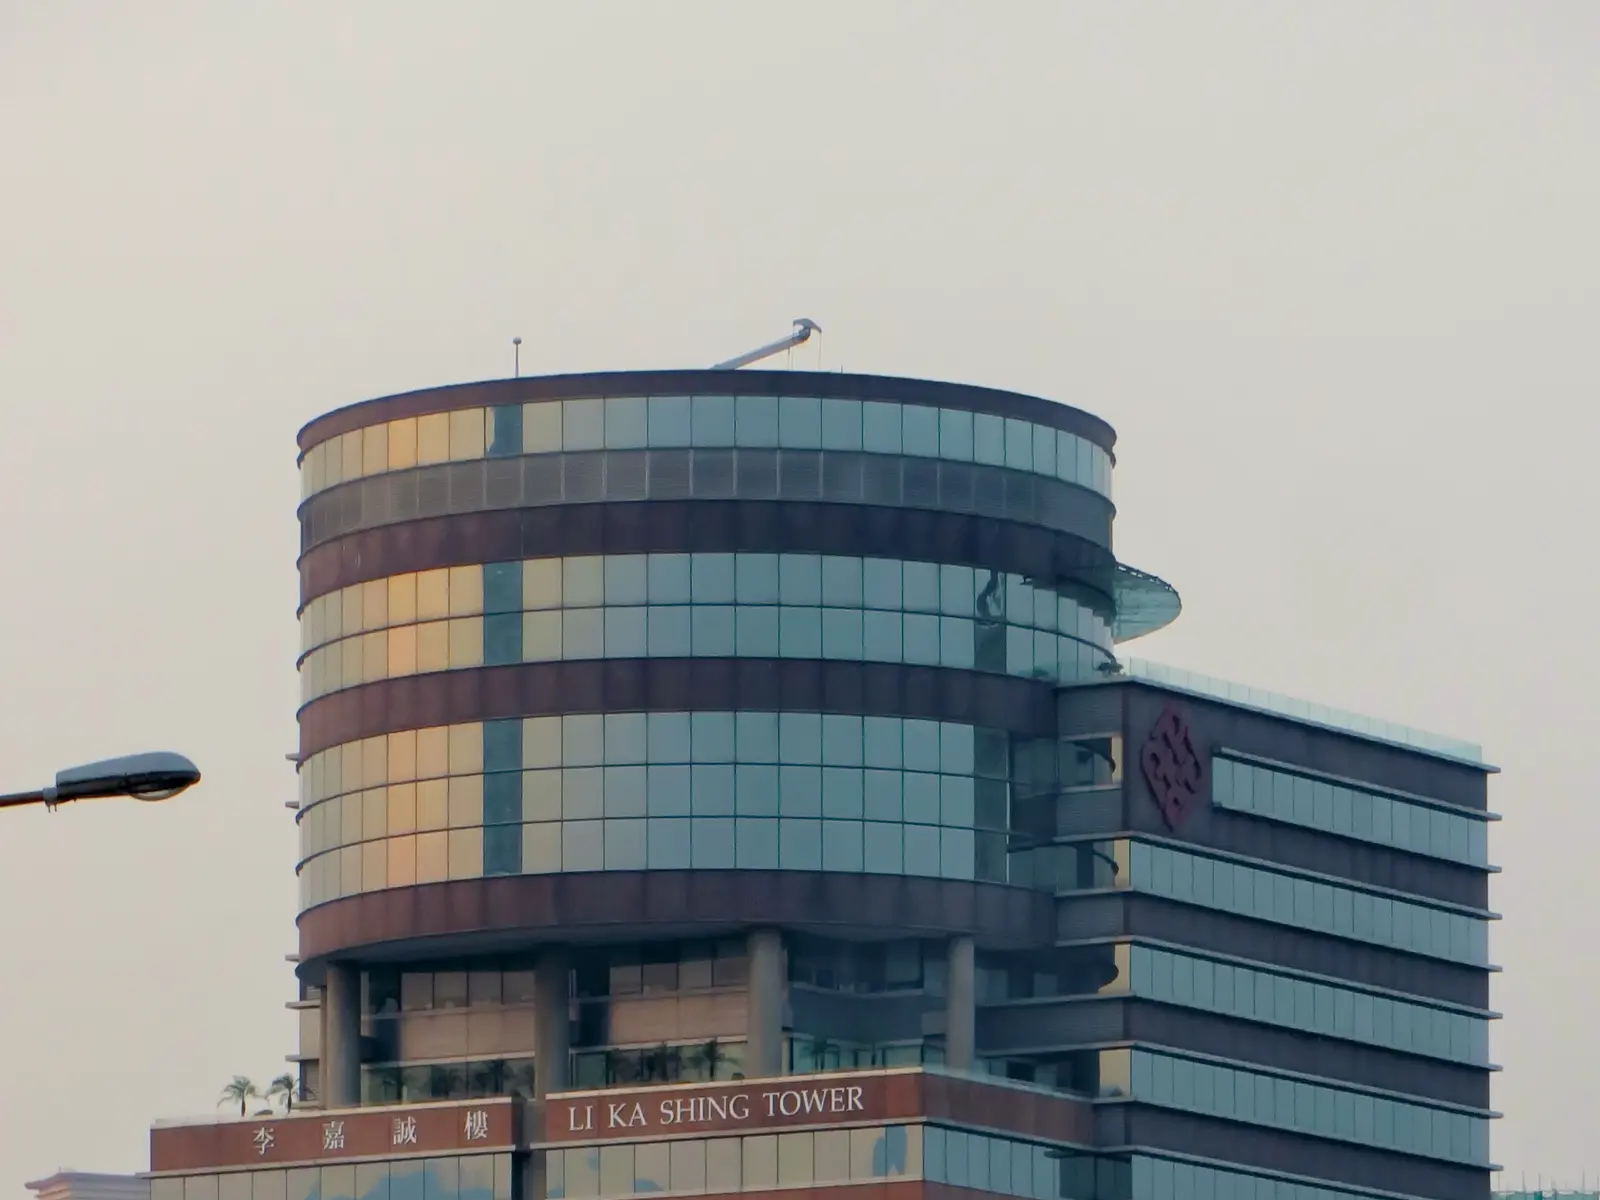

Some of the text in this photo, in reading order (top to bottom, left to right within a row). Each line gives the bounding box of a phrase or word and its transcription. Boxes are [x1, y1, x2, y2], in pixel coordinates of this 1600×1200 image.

[568, 1086, 865, 1131] LI KA SHING TOWER
[252, 1110, 489, 1155] 李嘉誠樓
